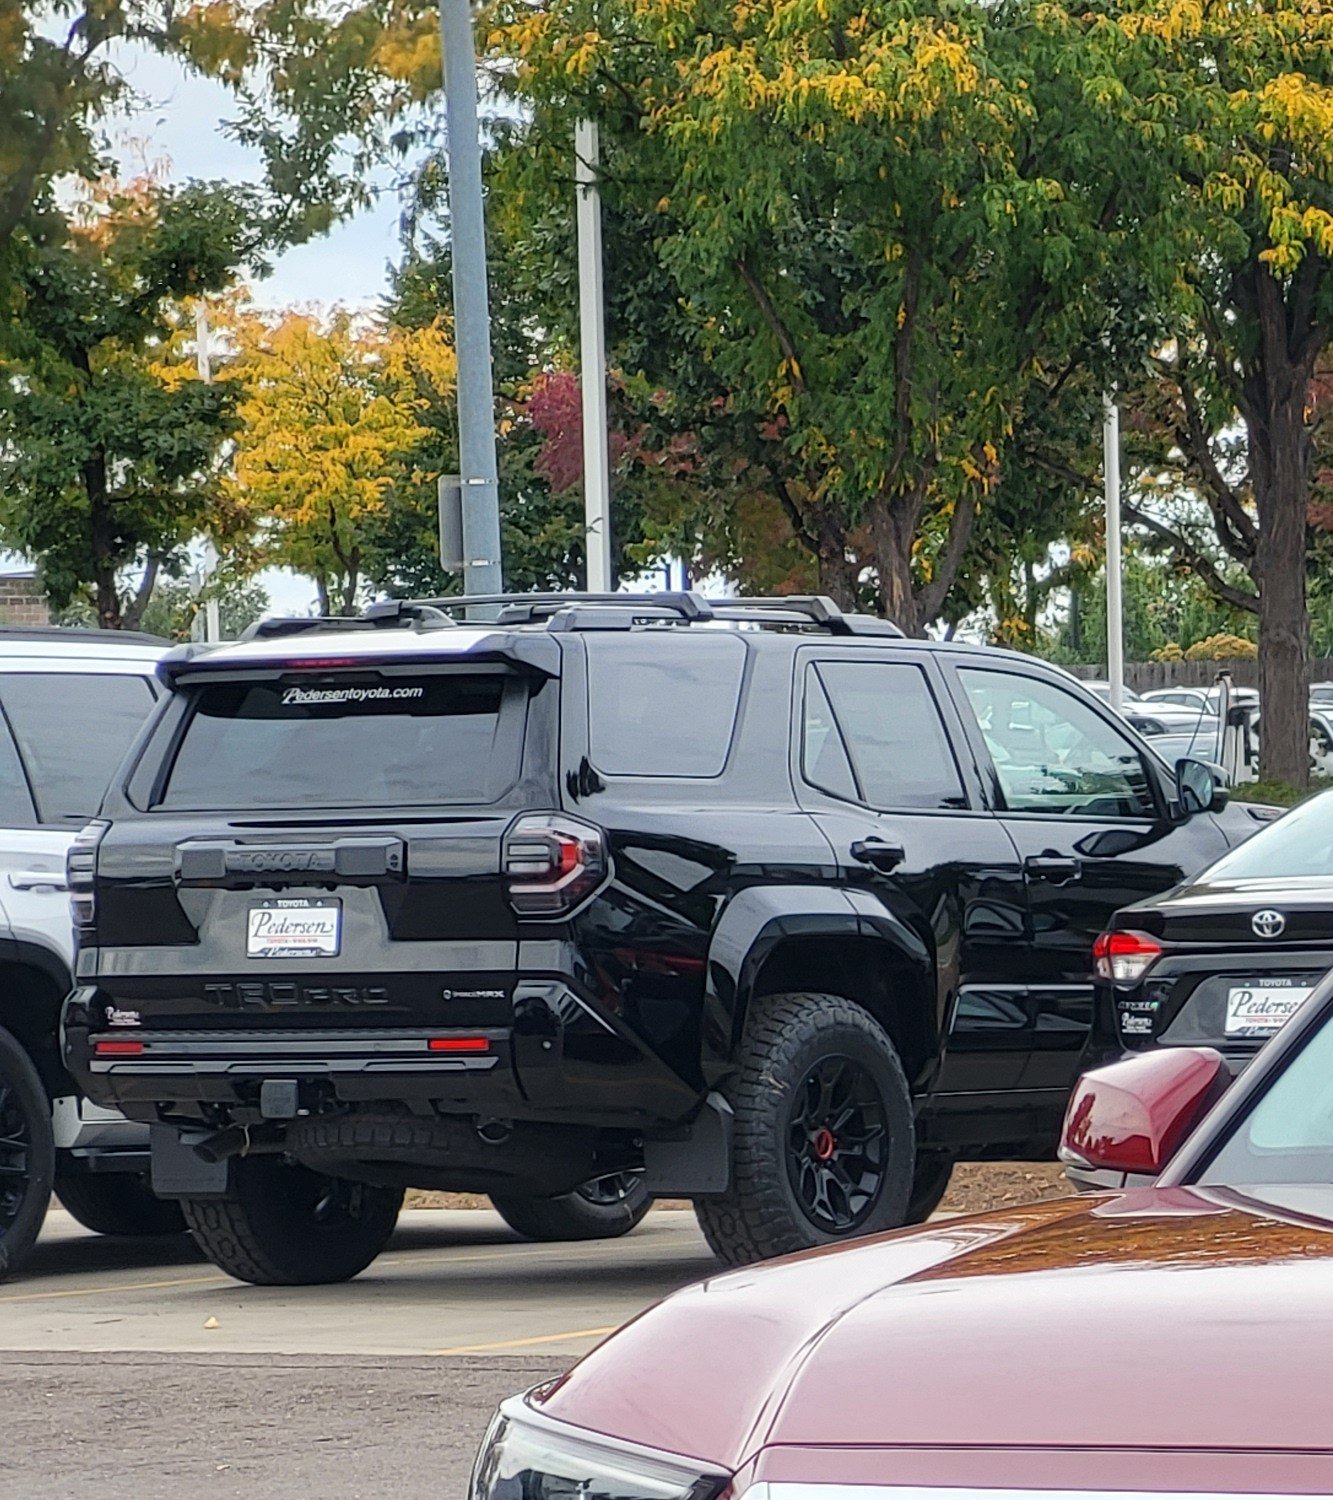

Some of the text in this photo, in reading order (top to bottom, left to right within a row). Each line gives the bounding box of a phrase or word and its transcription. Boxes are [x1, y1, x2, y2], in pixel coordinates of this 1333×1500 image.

[281, 687, 424, 704] Pedersentoyota.com
[251, 911, 334, 937] Pedersen
[1258, 979, 1292, 987] TOYOTA
[1230, 991, 1299, 1017] Pederse
